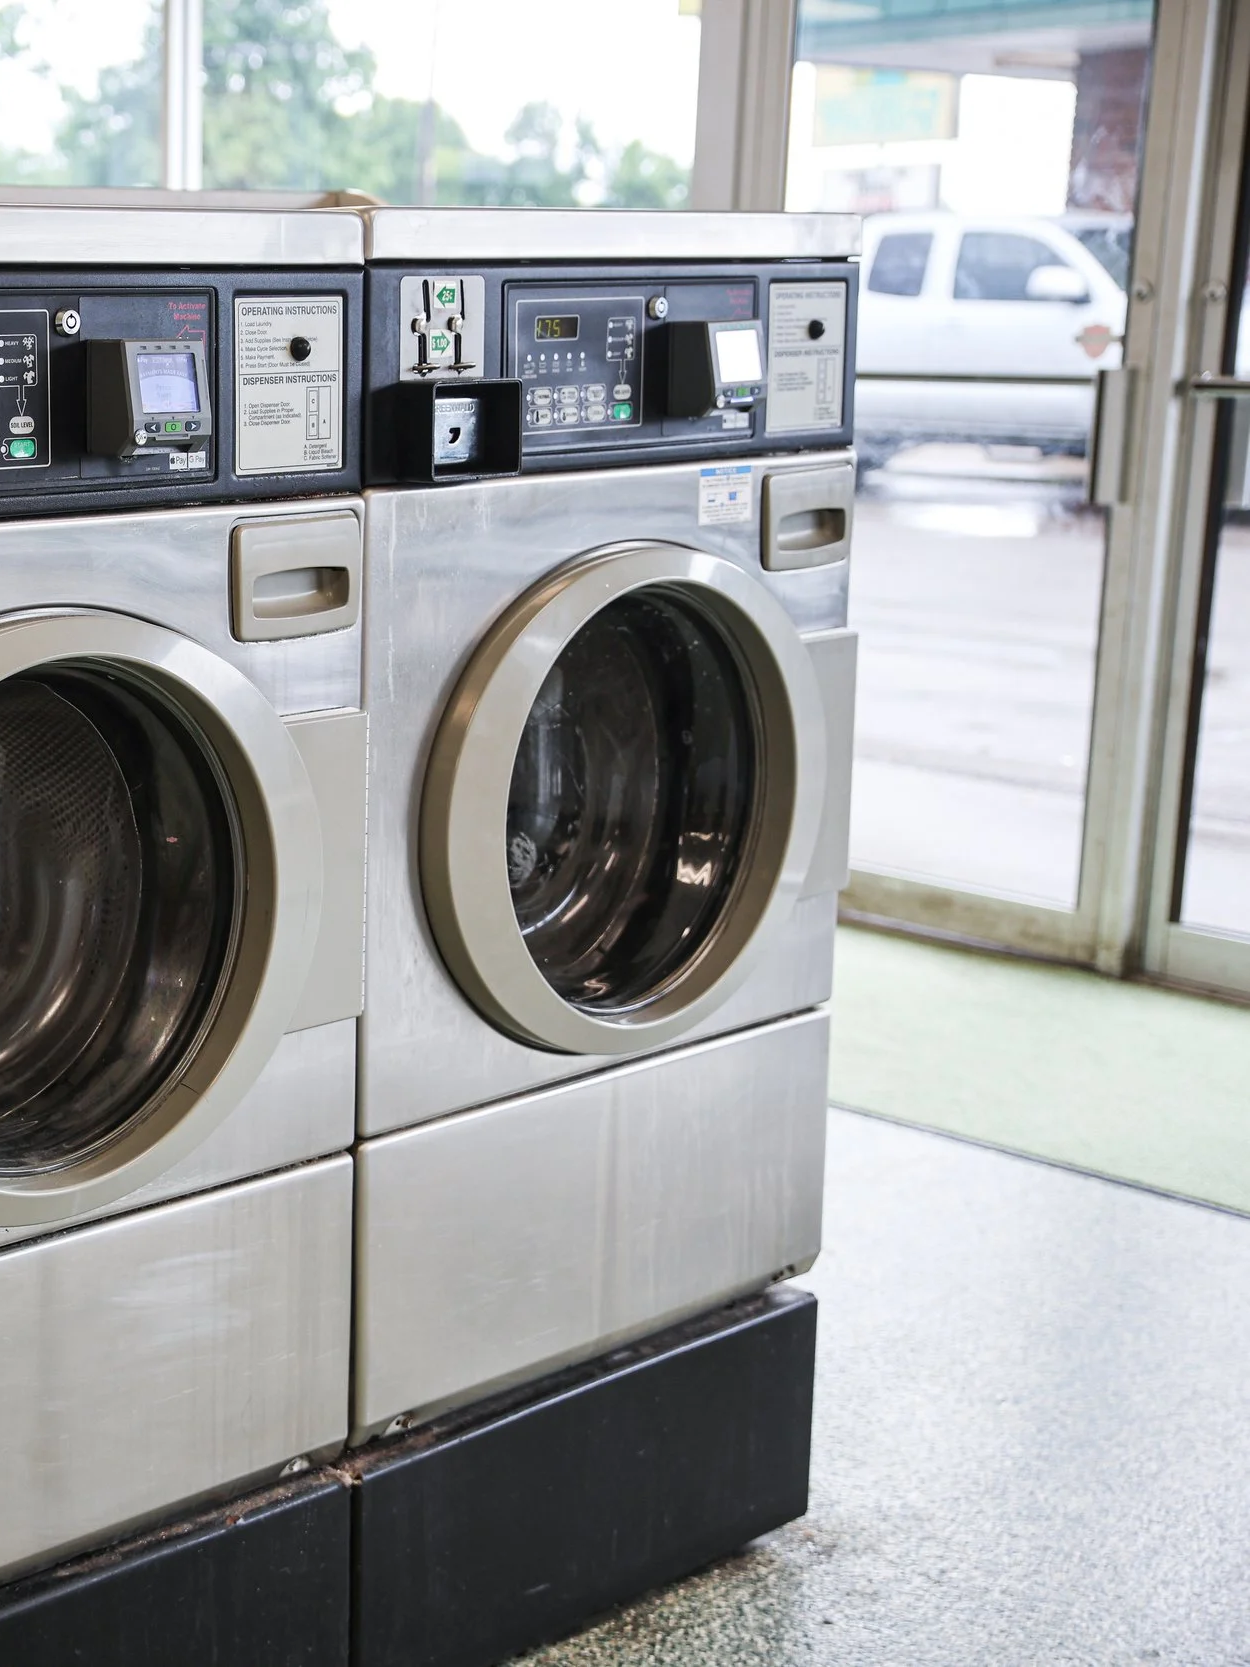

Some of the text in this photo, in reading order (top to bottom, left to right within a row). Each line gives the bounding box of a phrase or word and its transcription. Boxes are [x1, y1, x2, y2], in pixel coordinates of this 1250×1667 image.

[241, 305, 337, 316] OPERATING INSTRUCTIONS
[243, 374, 337, 386] DISPENSER INSTRUCTIONS
[176, 456, 187, 466] Pay
